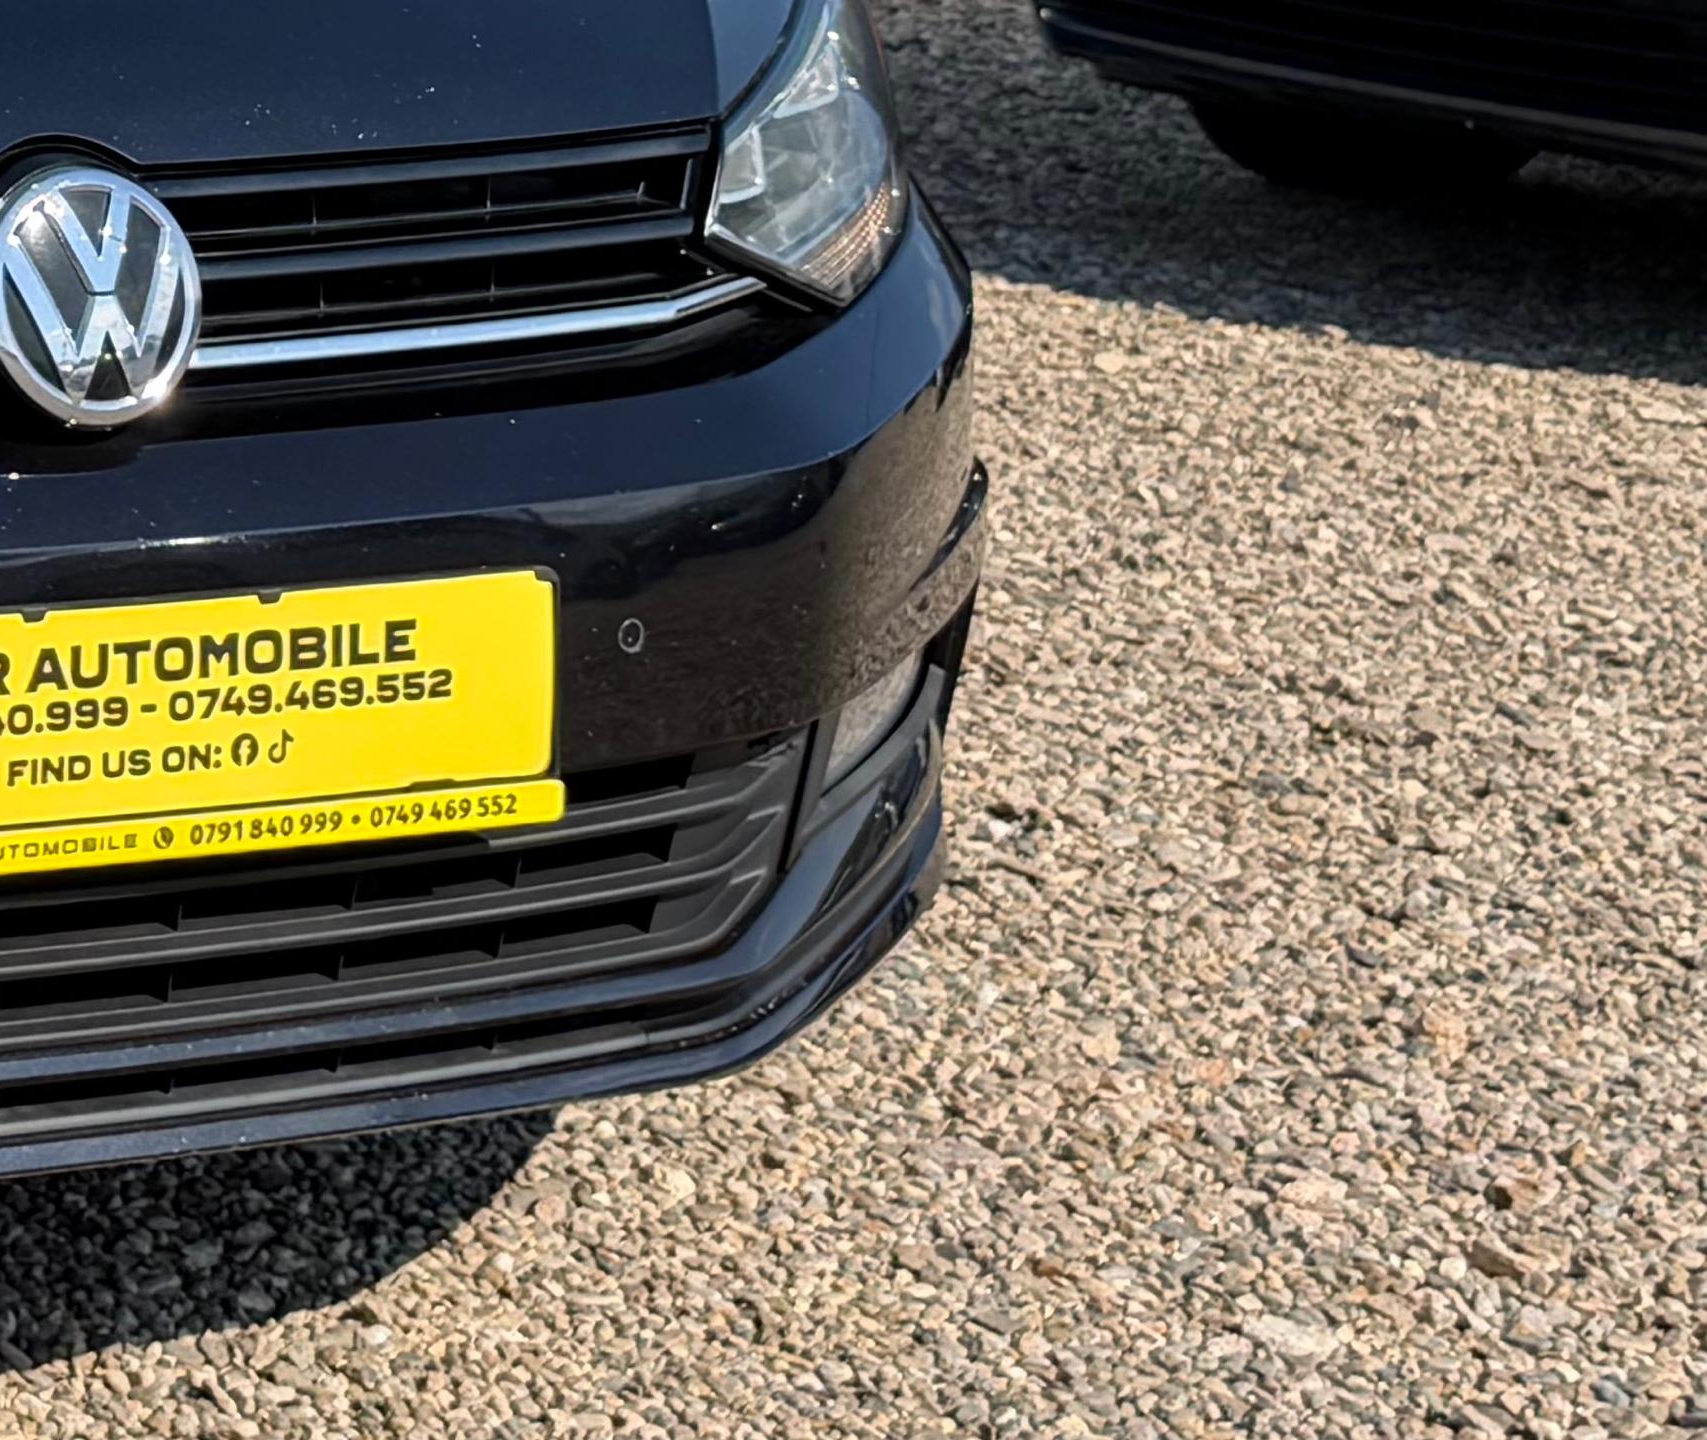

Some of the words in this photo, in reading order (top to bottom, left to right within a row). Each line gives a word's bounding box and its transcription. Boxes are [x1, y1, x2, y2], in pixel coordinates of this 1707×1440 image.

[25, 618, 418, 694] AUTOMOBILE
[168, 667, 453, 722] 0749.469.552
[6, 754, 92, 788] FIND
[101, 748, 152, 779] US
[161, 742, 223, 774] ON:
[189, 820, 244, 846] 0791
[249, 815, 294, 840] 840
[300, 810, 343, 835] 999
[370, 803, 424, 828] 0749
[429, 798, 472, 822] 469
[476, 793, 517, 818] 552
